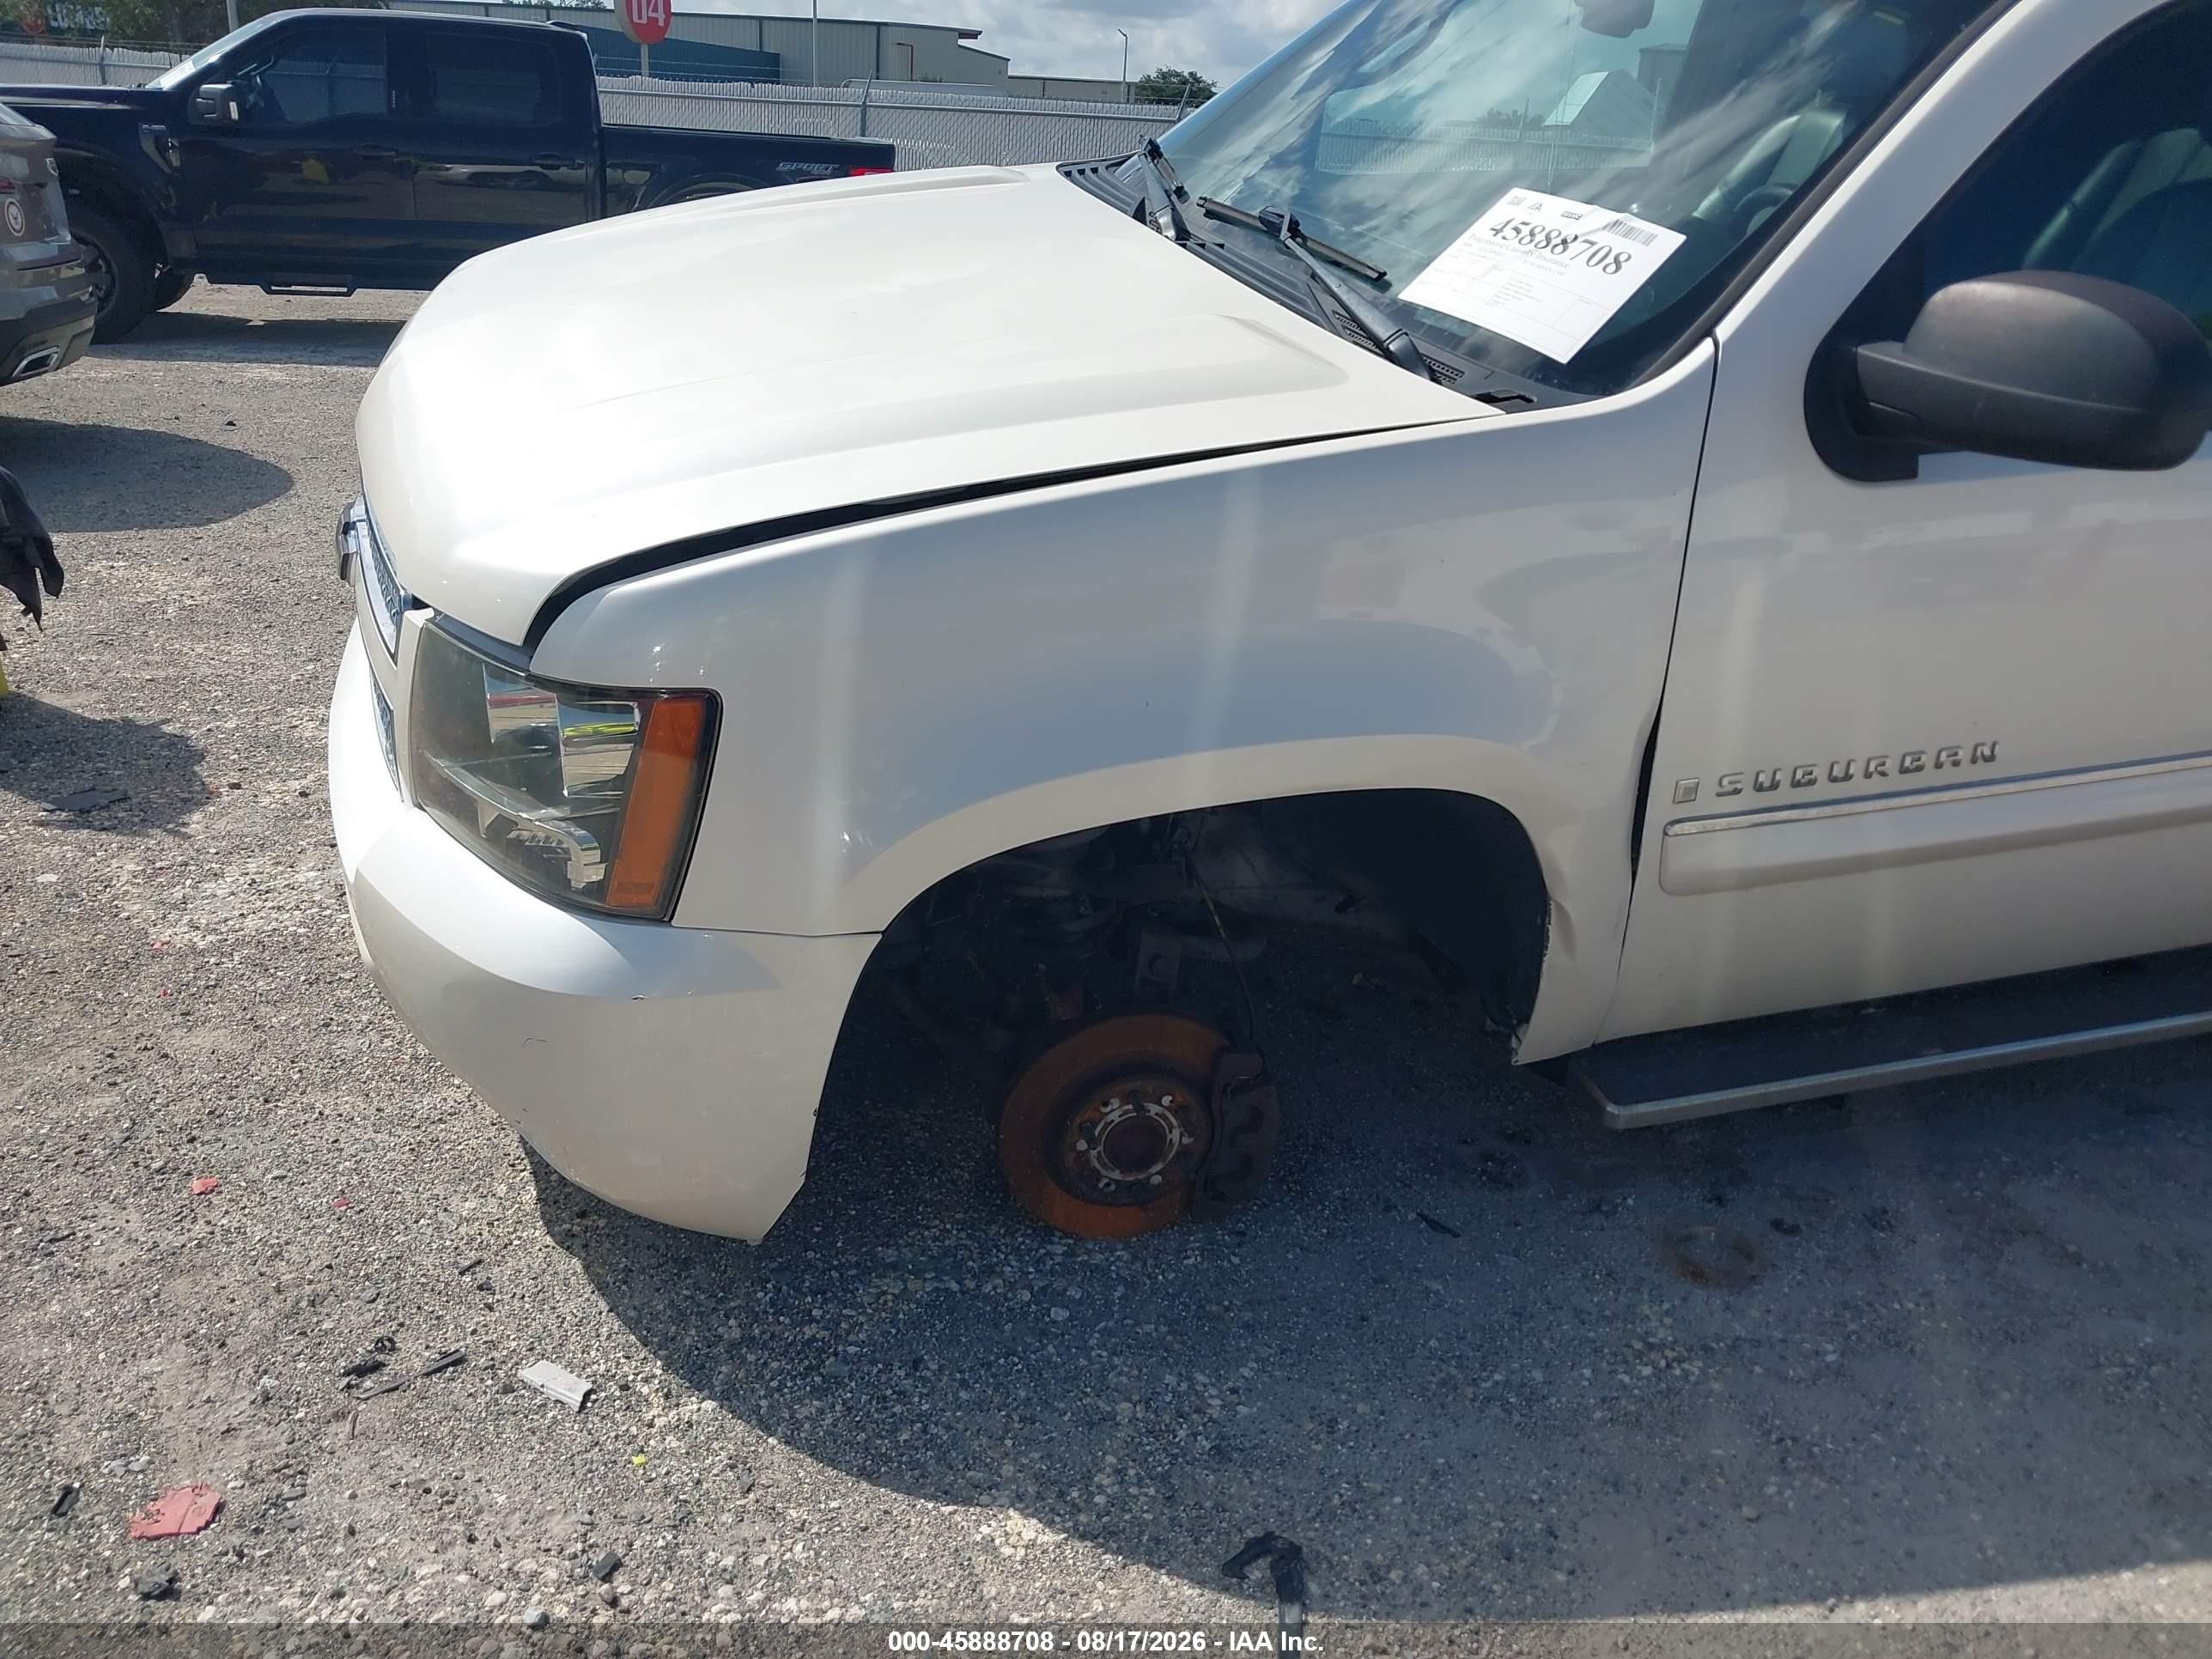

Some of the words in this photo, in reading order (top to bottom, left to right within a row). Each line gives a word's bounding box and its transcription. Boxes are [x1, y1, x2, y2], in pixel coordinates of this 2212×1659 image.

[775, 161, 839, 173] SPORT
[1489, 217, 1632, 275] 45888708
[1715, 740, 2000, 797] SUBURBAN
